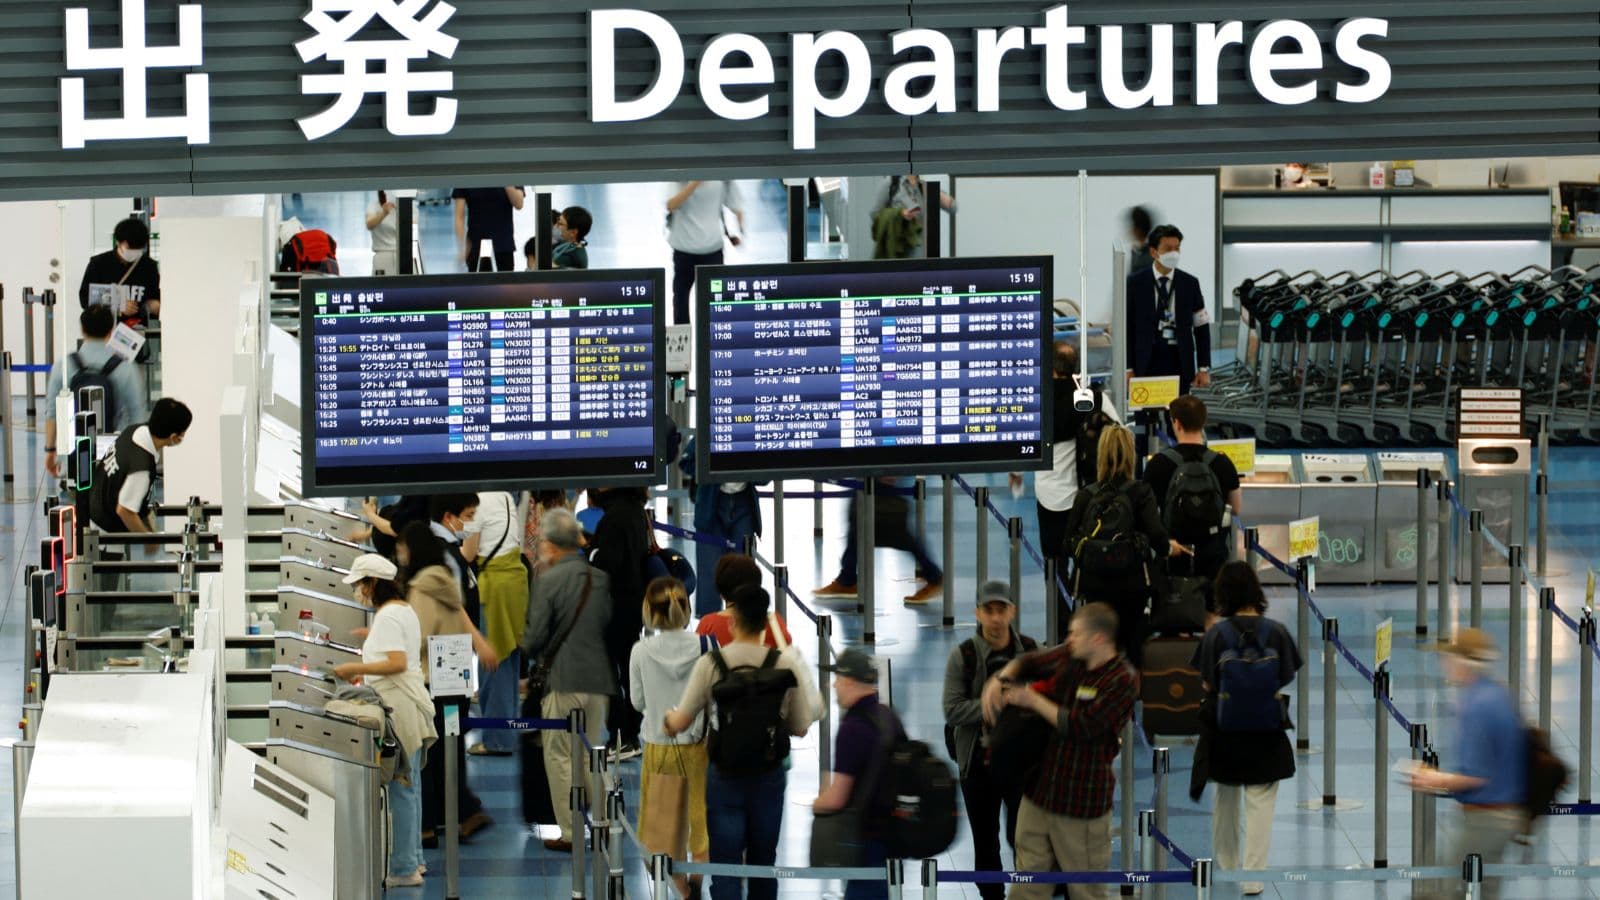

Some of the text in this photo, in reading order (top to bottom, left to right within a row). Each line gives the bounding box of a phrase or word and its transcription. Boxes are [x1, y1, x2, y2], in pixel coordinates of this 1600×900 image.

[61, 0, 1393, 150] 出発 Departures
[1010, 273, 1034, 283] 15 19
[621, 286, 646, 296] 15 19
